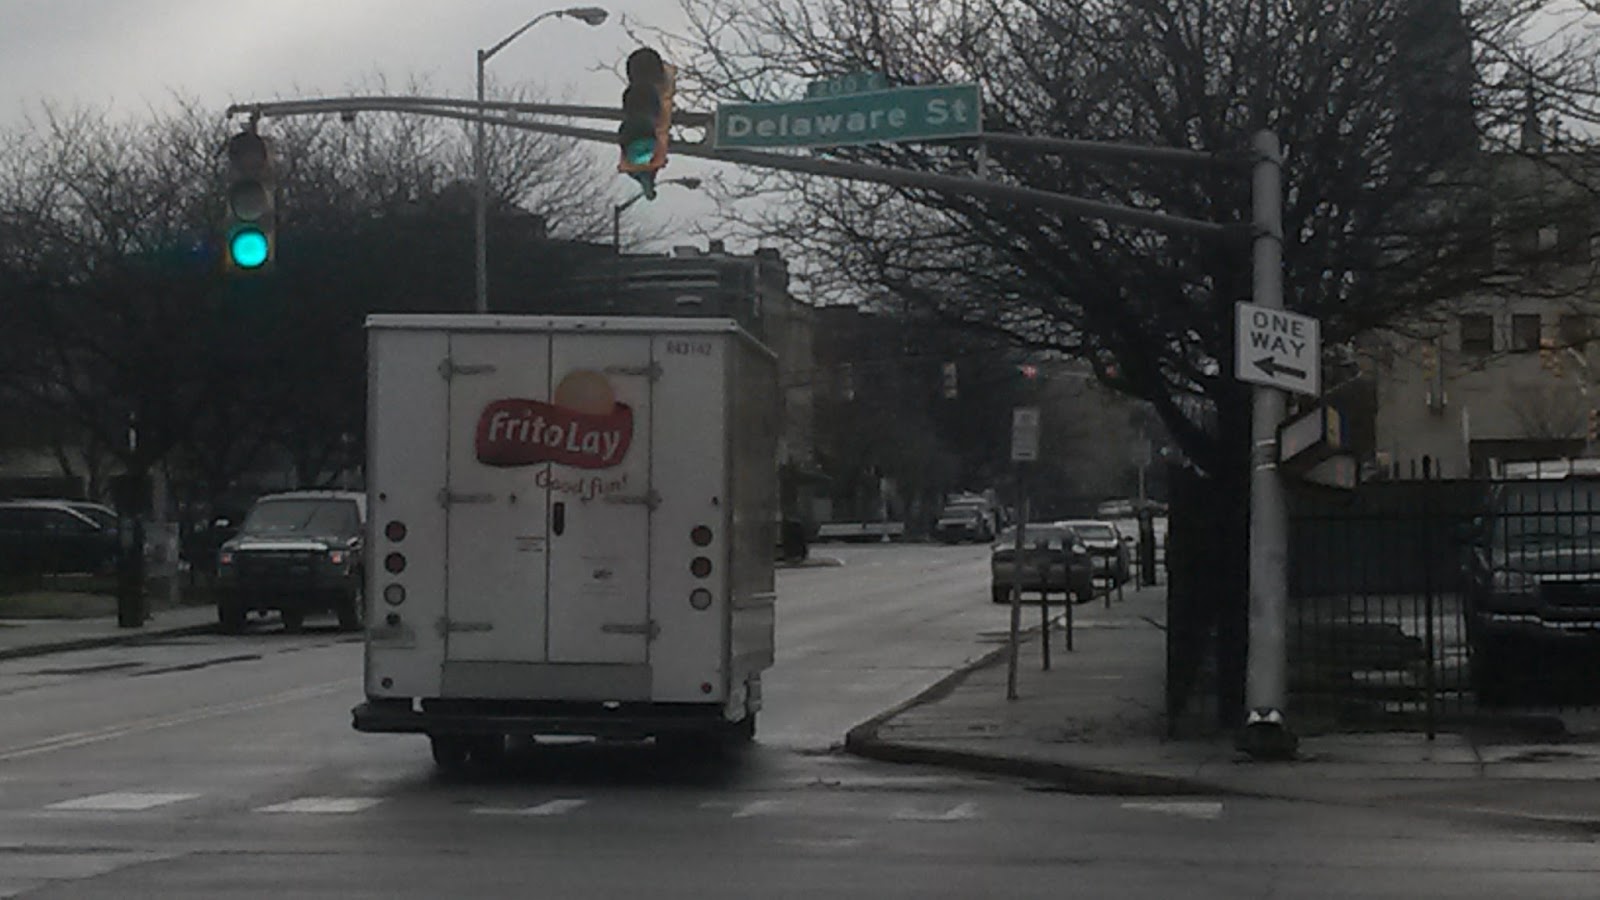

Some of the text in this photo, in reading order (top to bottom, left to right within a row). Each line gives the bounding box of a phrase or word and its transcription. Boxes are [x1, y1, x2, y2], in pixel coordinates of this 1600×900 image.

[727, 98, 967, 138] Delaware St
[1252, 311, 1305, 339] ONE
[1250, 331, 1305, 358] WAY
[535, 469, 585, 494] Good
